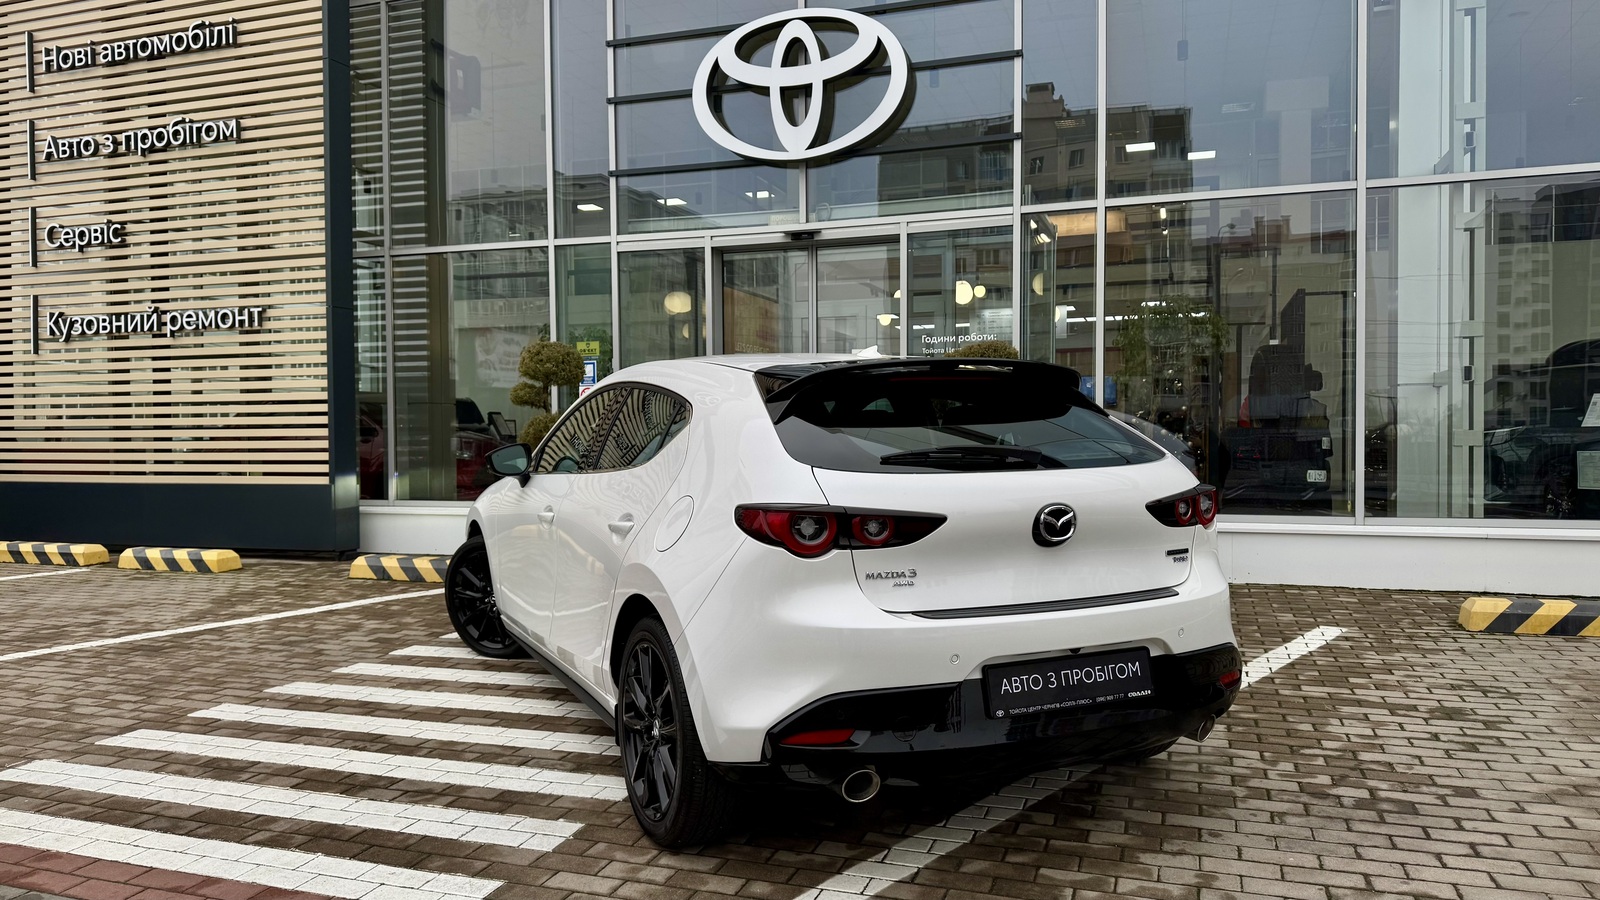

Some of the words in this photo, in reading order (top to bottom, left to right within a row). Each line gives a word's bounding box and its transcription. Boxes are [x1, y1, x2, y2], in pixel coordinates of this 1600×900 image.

[42, 40, 93, 72] Нові
[100, 17, 235, 64] автомобілі
[43, 135, 96, 160] Авто
[102, 133, 115, 153] з
[122, 117, 238, 156] пробігом
[45, 219, 123, 252] Сервіс
[47, 306, 158, 342] Кузовний
[167, 307, 262, 338] ремонт
[921, 335, 956, 344] Години
[958, 333, 997, 343] роботи:
[1001, 674, 1042, 695] АВТО
[1048, 672, 1057, 689] З
[1061, 661, 1141, 687] ПРОБІГОМ
